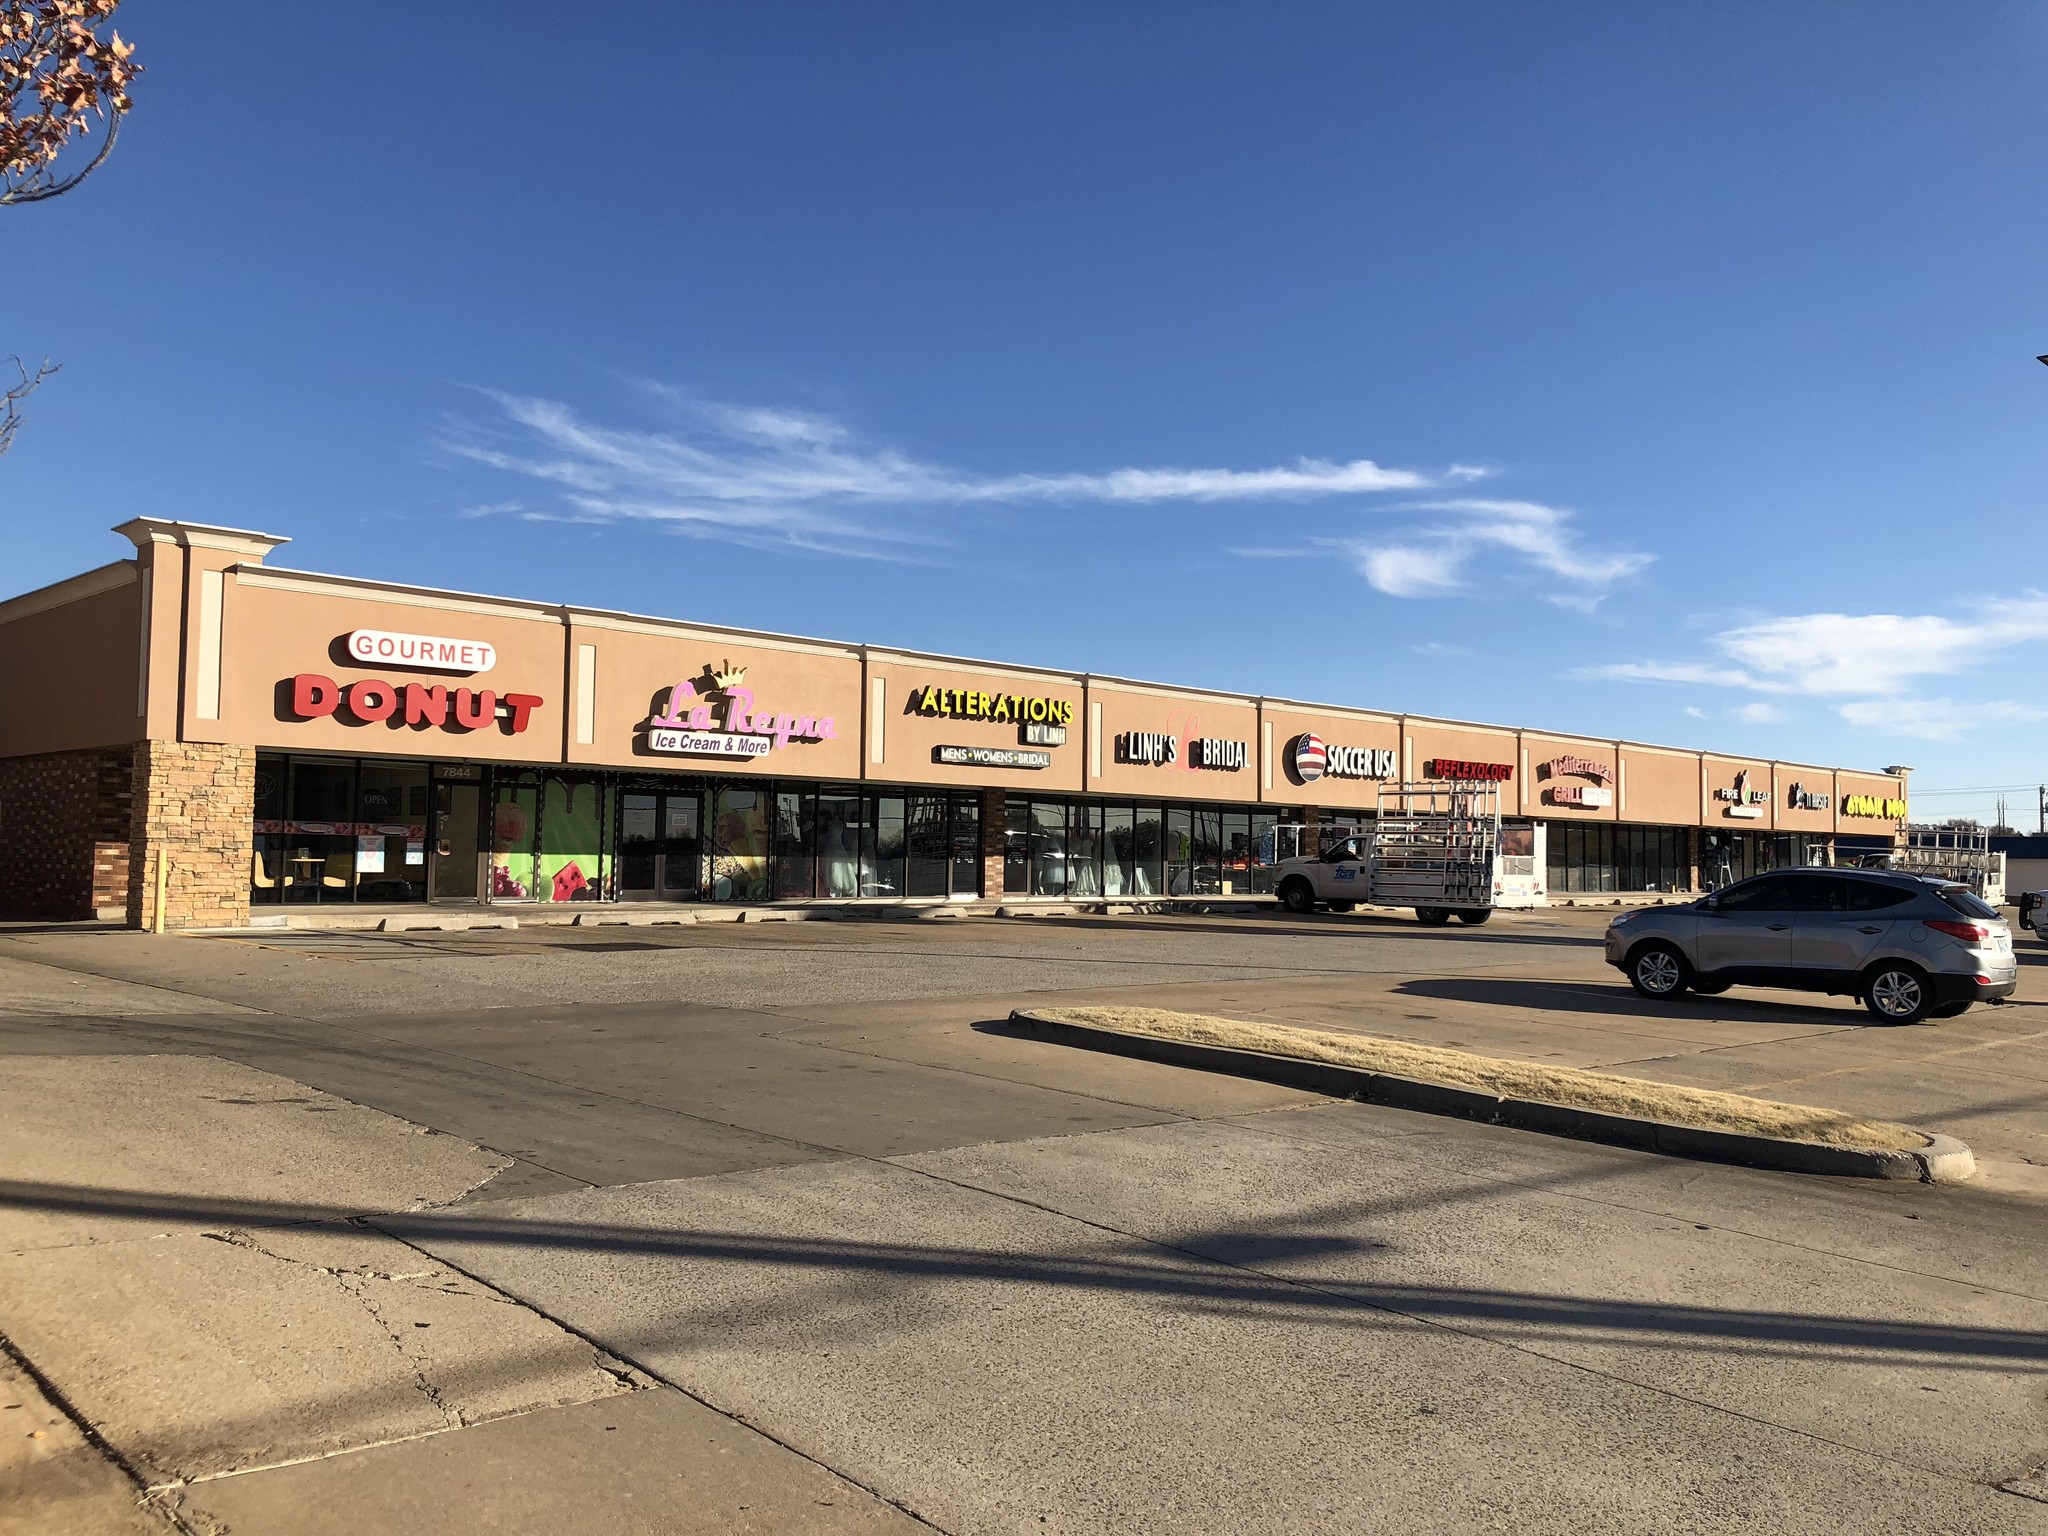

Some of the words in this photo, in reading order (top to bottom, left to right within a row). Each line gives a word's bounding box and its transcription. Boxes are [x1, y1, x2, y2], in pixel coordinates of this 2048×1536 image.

[356, 636, 491, 666] GOURMET
[293, 673, 544, 733] DONUT
[920, 685, 1075, 724] ALTERATIONS
[650, 681, 713, 730] La
[723, 687, 838, 750] Reyna
[655, 732, 676, 749] Ice
[680, 734, 720, 751] Cream
[725, 738, 733, 751] &
[737, 740, 768, 754] More
[1027, 724, 1040, 742] BY
[1044, 727, 1066, 744] LINH
[940, 747, 967, 761] MENS
[973, 750, 1014, 763] WOMENS
[1018, 752, 1050, 766] BRIDAL
[1128, 731, 1177, 763] LINH'S
[1203, 738, 1252, 768] BRIDAL
[443, 767, 471, 778] 7844
[1327, 745, 1373, 776] SOCCER
[1374, 749, 1397, 778] USA
[1435, 759, 1514, 781] REFLEXOLOGY
[1550, 756, 1614, 782] Mediterranean
[364, 794, 388, 805] OPEN
[1553, 786, 1582, 804] GRILL
[1721, 788, 1739, 800] FIRE
[1753, 791, 1772, 802] LEAF
